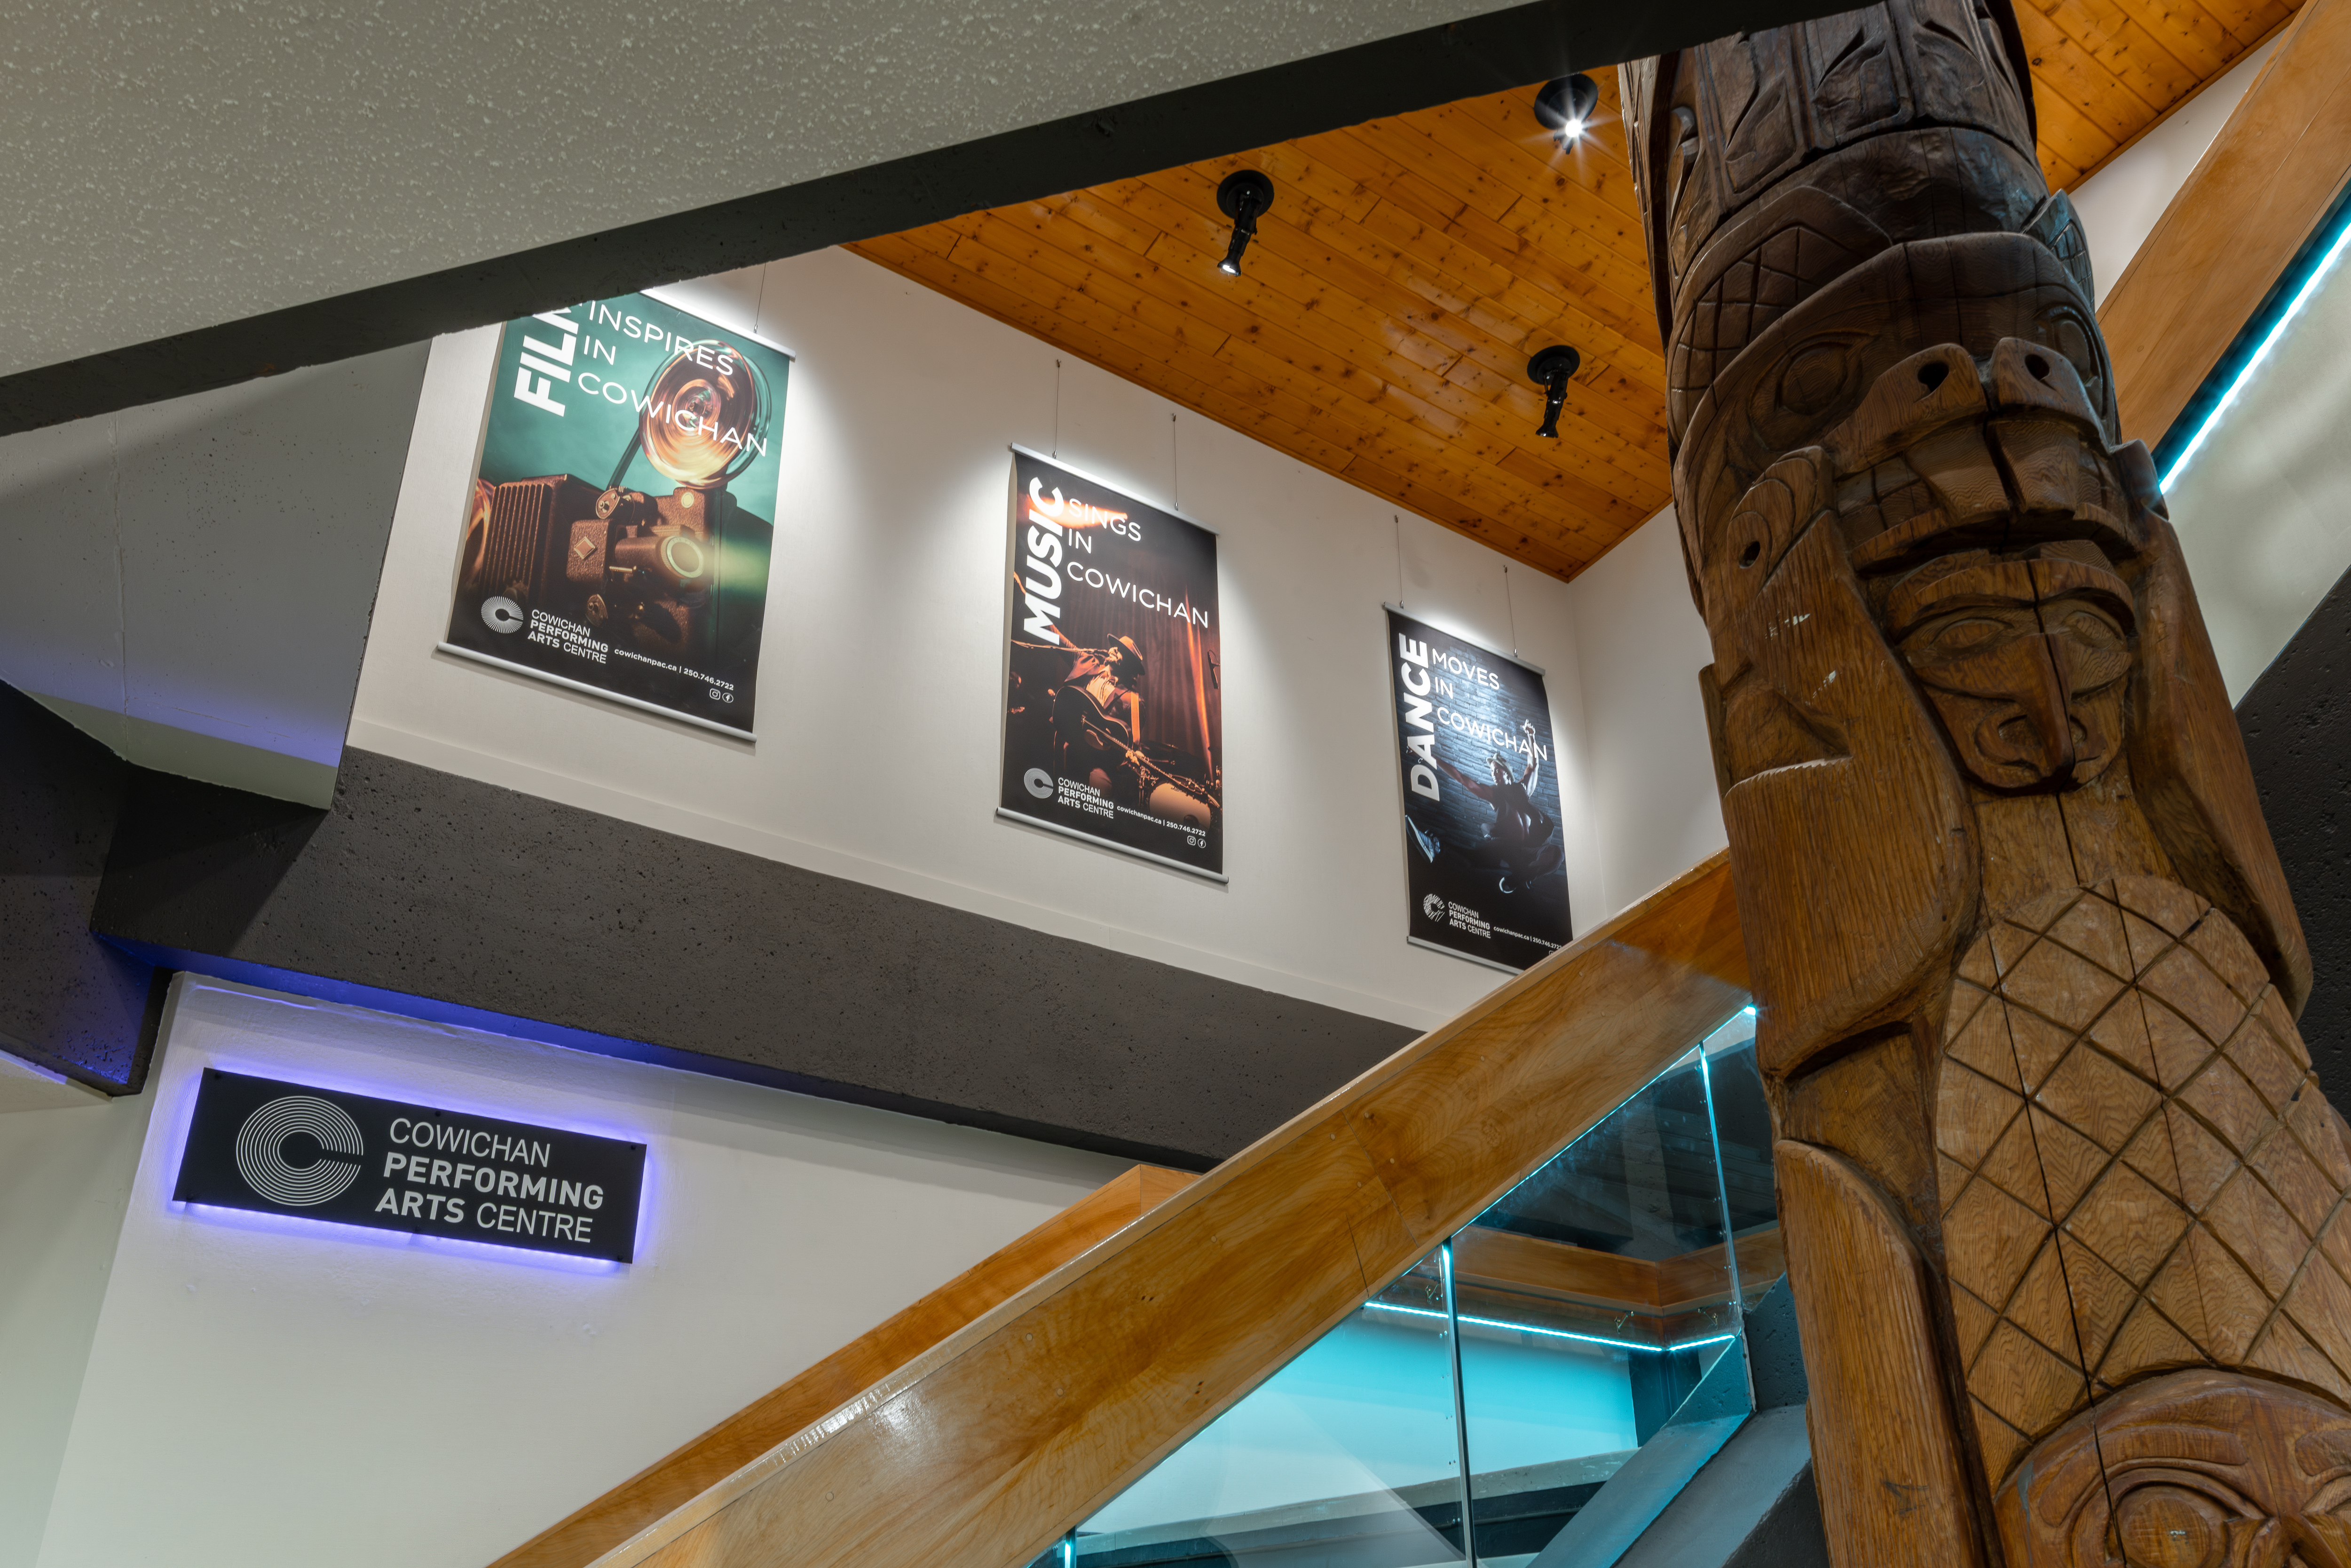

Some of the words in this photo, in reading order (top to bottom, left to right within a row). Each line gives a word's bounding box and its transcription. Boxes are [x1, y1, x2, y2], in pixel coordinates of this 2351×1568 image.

[583, 335, 616, 365] IN
[589, 300, 734, 375] INSPIRES
[578, 372, 767, 457] COWICHAN
[1069, 498, 1142, 541] SINGS
[1068, 528, 1092, 554] IN
[1023, 477, 1065, 645] MUSIC
[1067, 561, 1208, 629] COWICHAN
[530, 619, 608, 653] PERFORMING
[532, 609, 590, 637] COWICHAN
[527, 631, 560, 648] ARTS
[564, 642, 607, 664] CENTRE
[614, 648, 677, 671] cowichanpac.ca
[684, 668, 734, 690] 250.746.2722
[1433, 648, 1499, 690] MOVES
[1435, 677, 1453, 699] IN
[1399, 632, 1440, 801] DANCE
[1437, 707, 1547, 761] COWICHAN
[1058, 777, 1100, 797] COWICHAN
[1058, 786, 1114, 809] PERFORMING
[1058, 795, 1080, 808] ARTS
[1083, 803, 1113, 819] CENTRE
[1117, 805, 1161, 824] cowichanpac.ca
[1167, 821, 1206, 836] 250.746.2722
[1448, 901, 1479, 919] COWICHAN
[1449, 909, 1490, 930] PERFORMING
[1449, 918, 1466, 930] ARTS
[1468, 924, 1491, 938] CENTRE
[1493, 926, 1529, 940] cowichanpac.ca
[390, 1118, 551, 1167] COWICHAN
[383, 1151, 603, 1209] PERFORMING
[374, 1188, 465, 1223] ARTS
[476, 1202, 593, 1244] CENTRE
